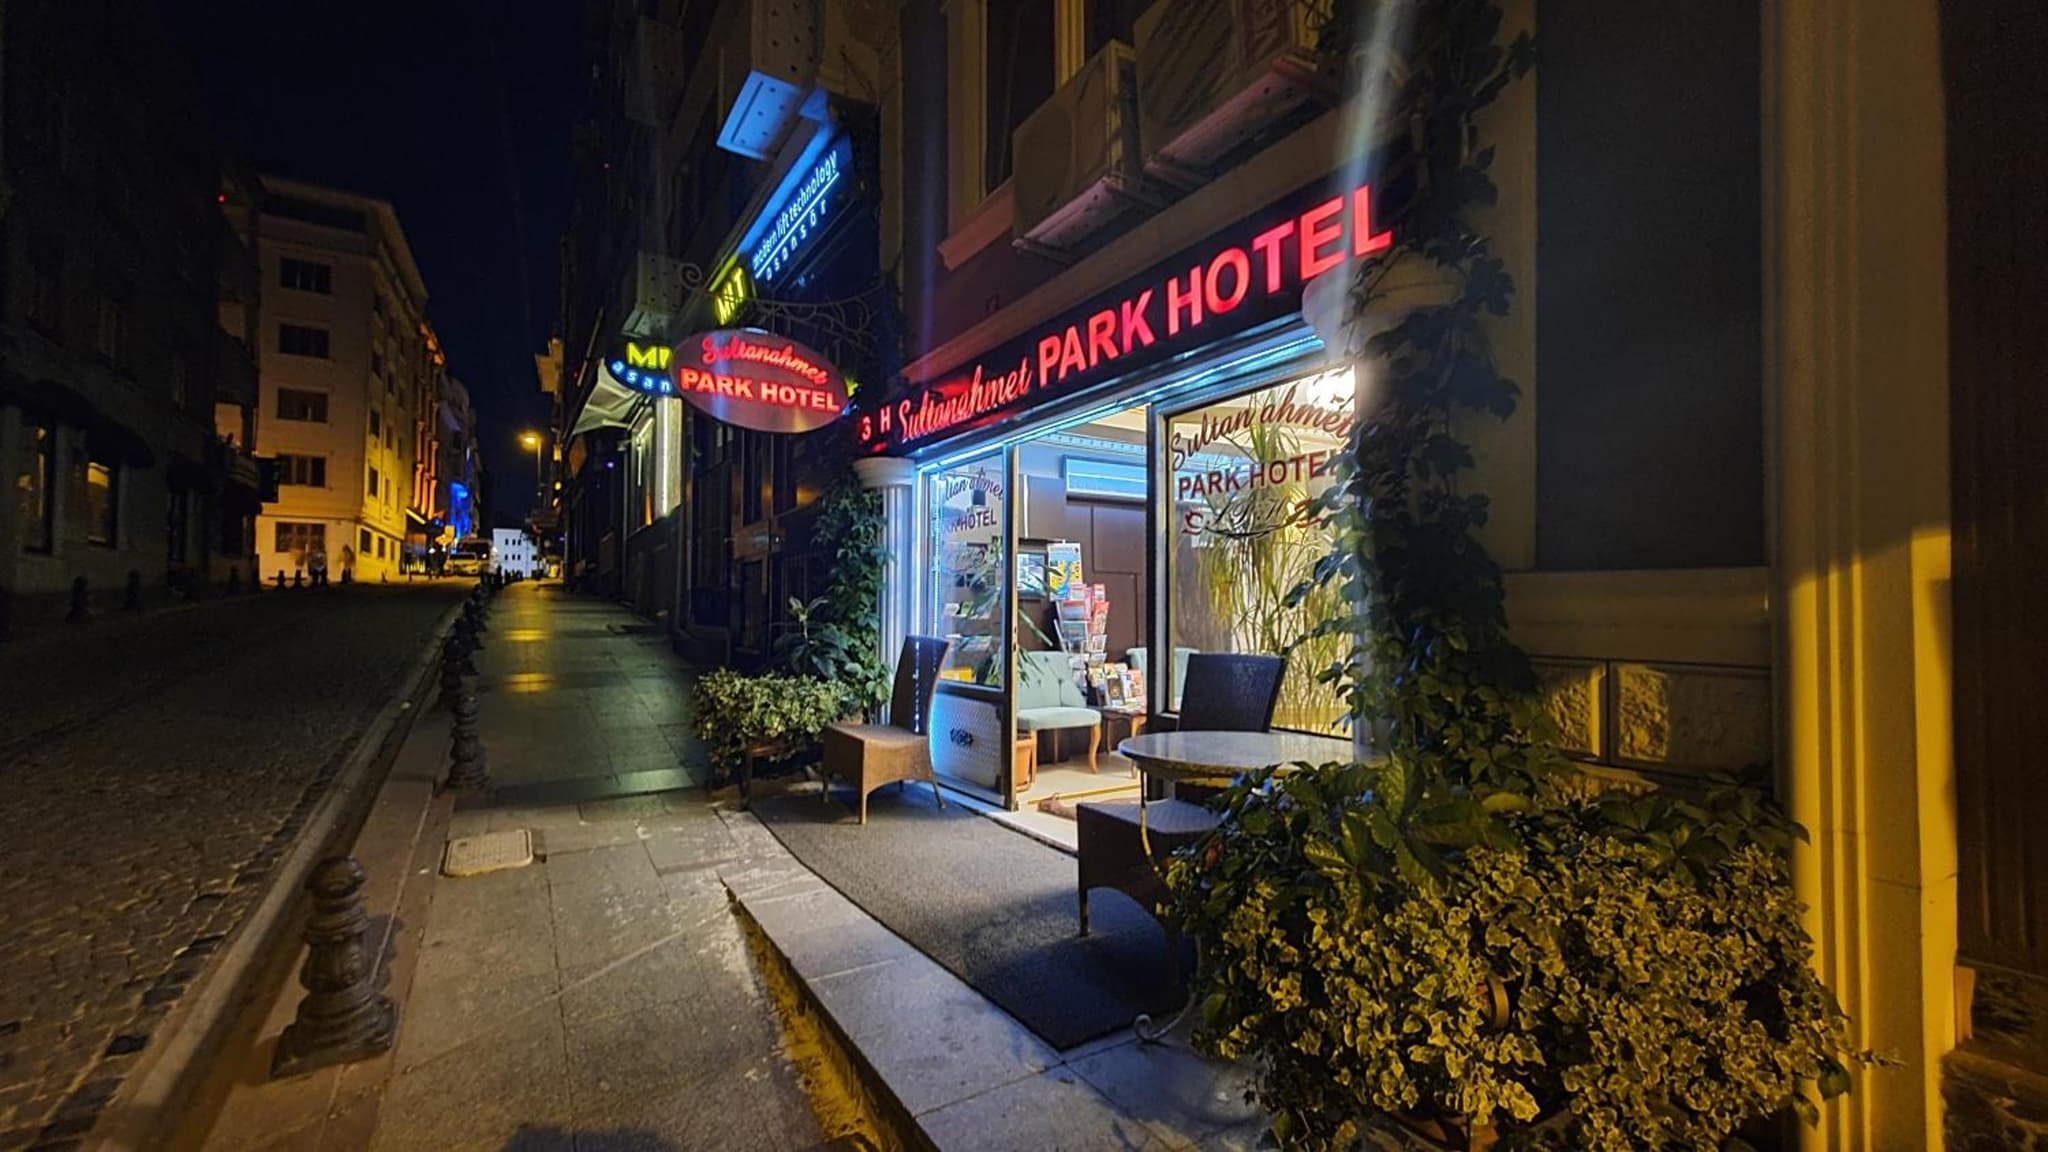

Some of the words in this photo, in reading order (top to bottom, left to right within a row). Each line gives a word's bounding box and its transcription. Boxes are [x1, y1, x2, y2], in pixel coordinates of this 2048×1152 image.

[788, 150, 838, 221] technology
[899, 357, 1033, 443] Sultanahmet
[1037, 289, 1156, 388] PARK
[1166, 184, 1393, 335] HOTEL
[680, 367, 754, 399] PARK
[760, 382, 842, 412] HOTEL
[1178, 466, 1241, 500] PARK
[960, 509, 998, 531] HOTEL
